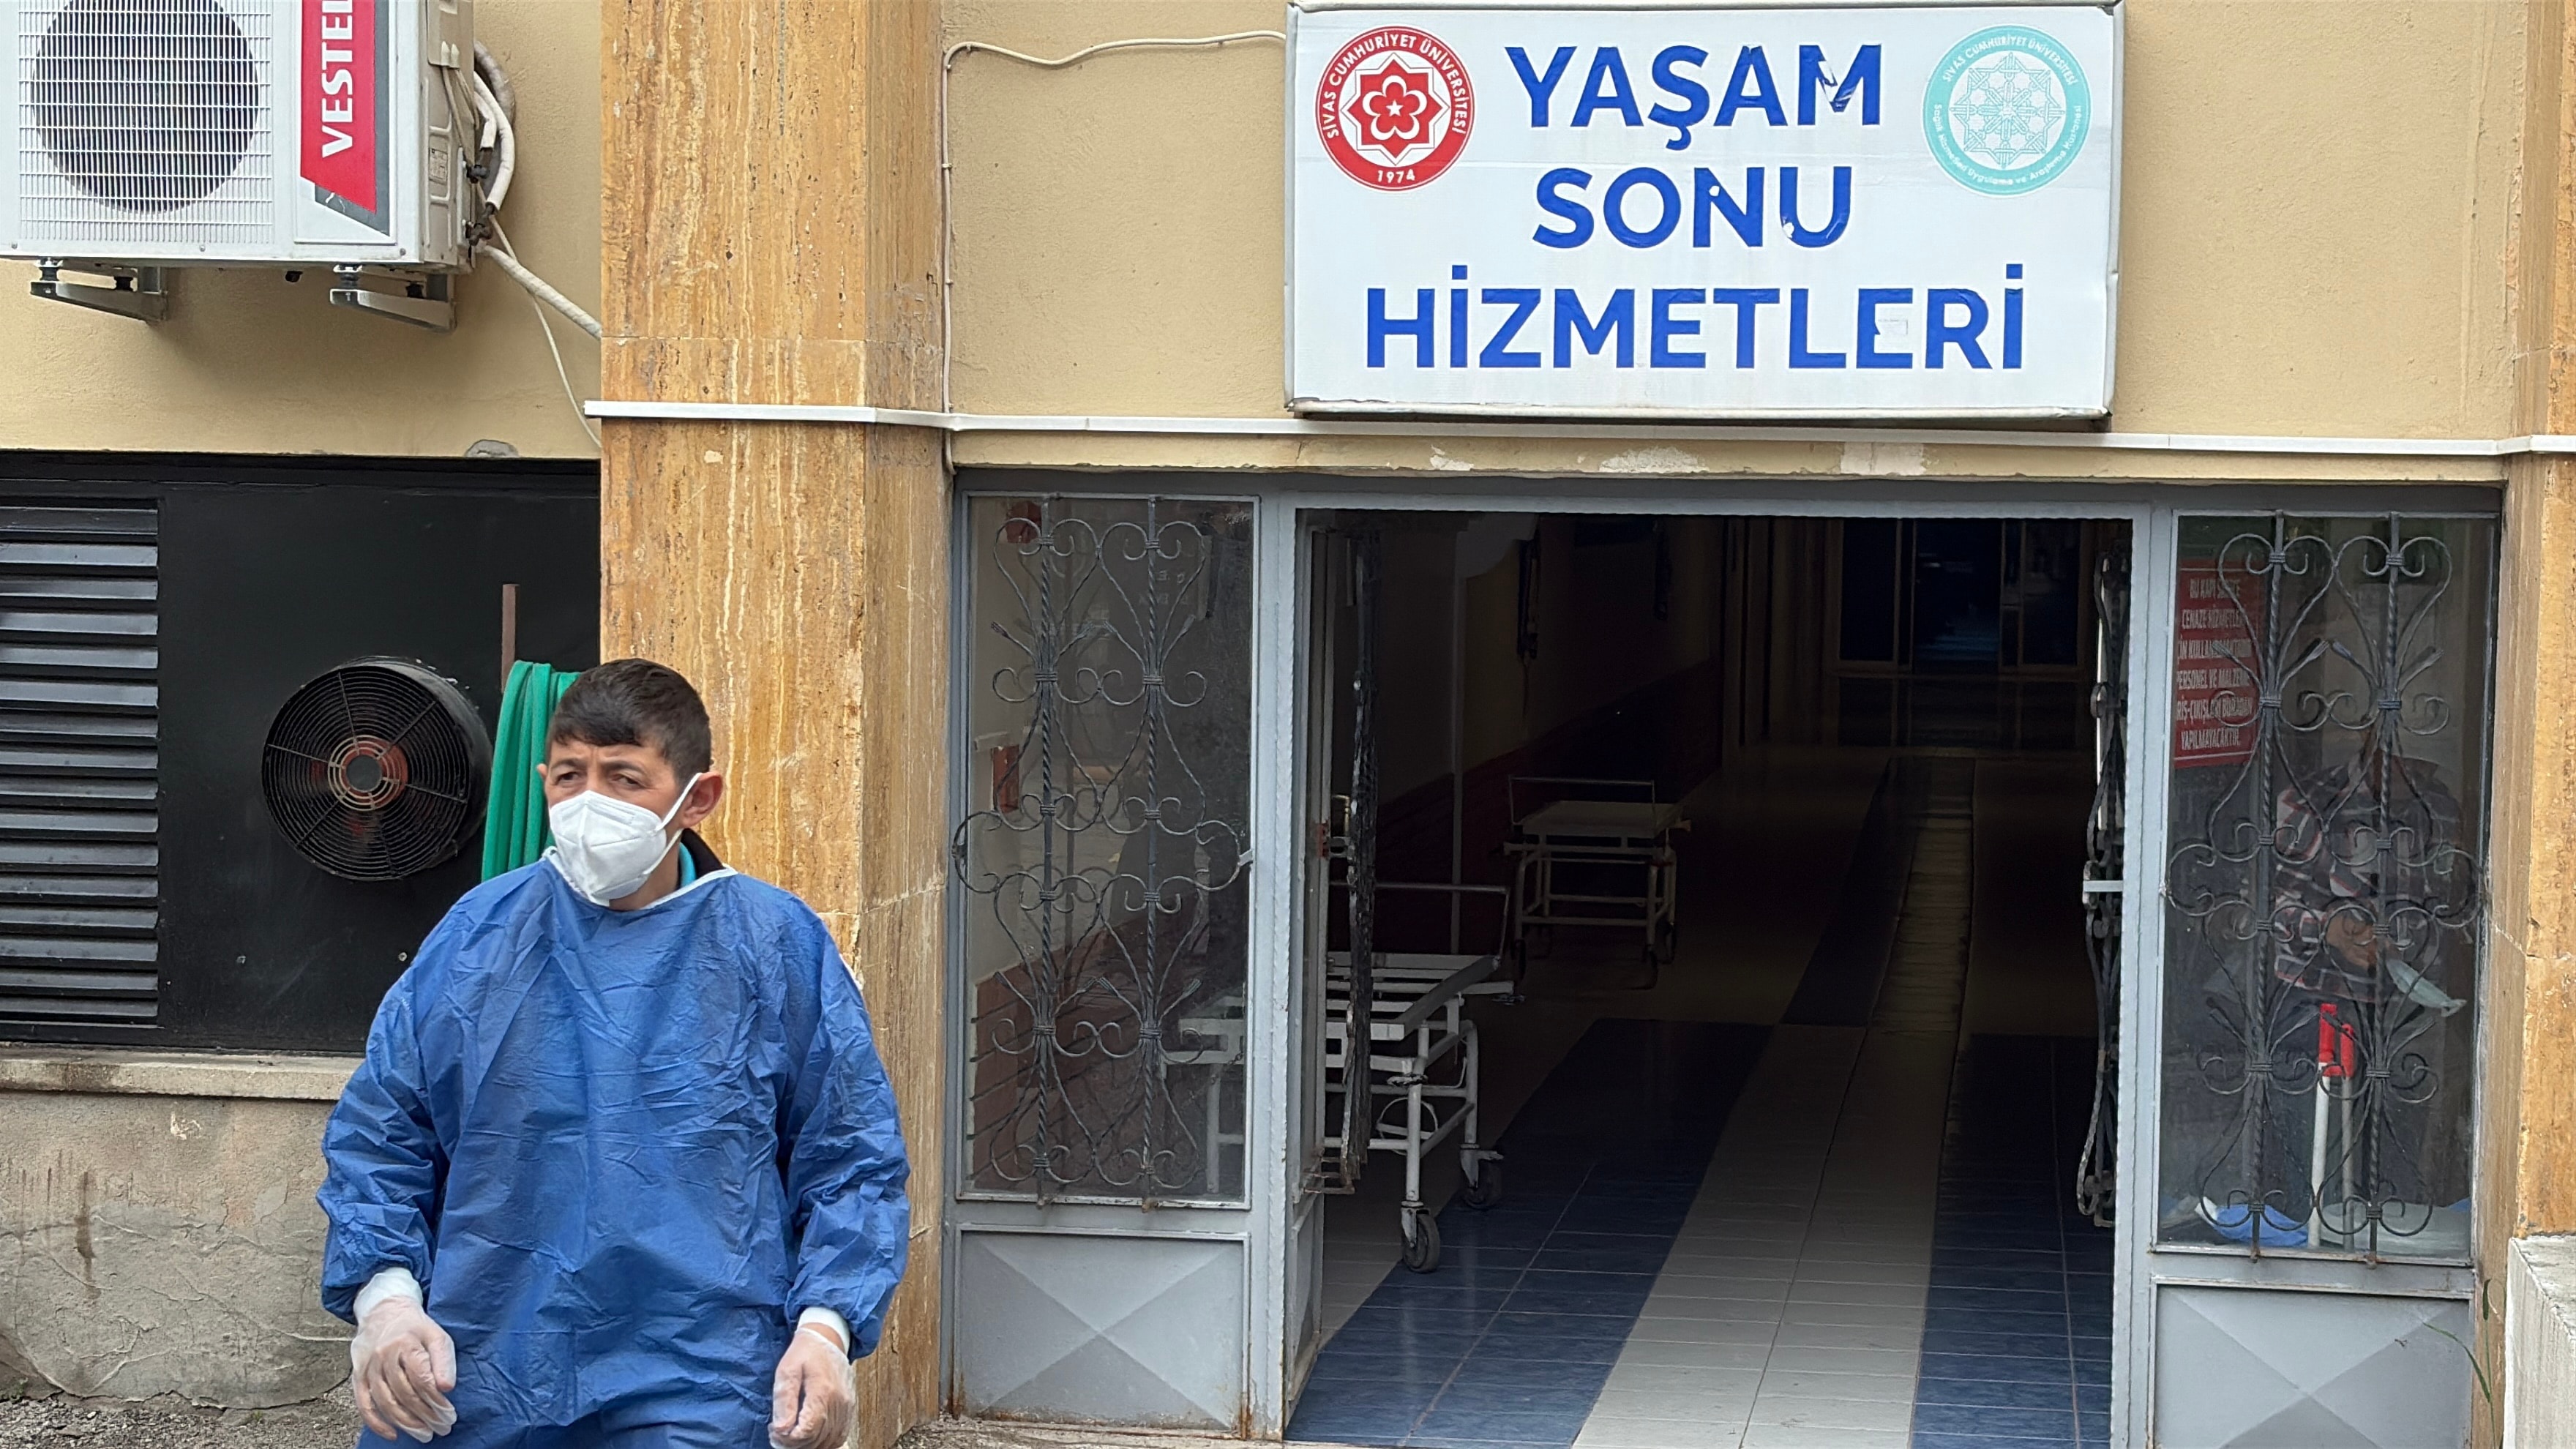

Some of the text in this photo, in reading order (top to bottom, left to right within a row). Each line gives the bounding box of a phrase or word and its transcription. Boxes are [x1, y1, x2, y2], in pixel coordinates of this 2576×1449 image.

[322, 0, 353, 157] VESTEL
[1322, 31, 1470, 139] SİVAS CUMHURİYET ÜNİVERSİTESİ
[1505, 44, 1882, 151] YAŞAM
[1965, 34, 2027, 58] CUMHURİYET
[2028, 36, 2078, 86] ÜNİVERSİTESİ
[1377, 169, 1415, 184] 1974
[1533, 166, 1853, 248] SONU
[1367, 263, 2023, 370] HİZMETLERİ
